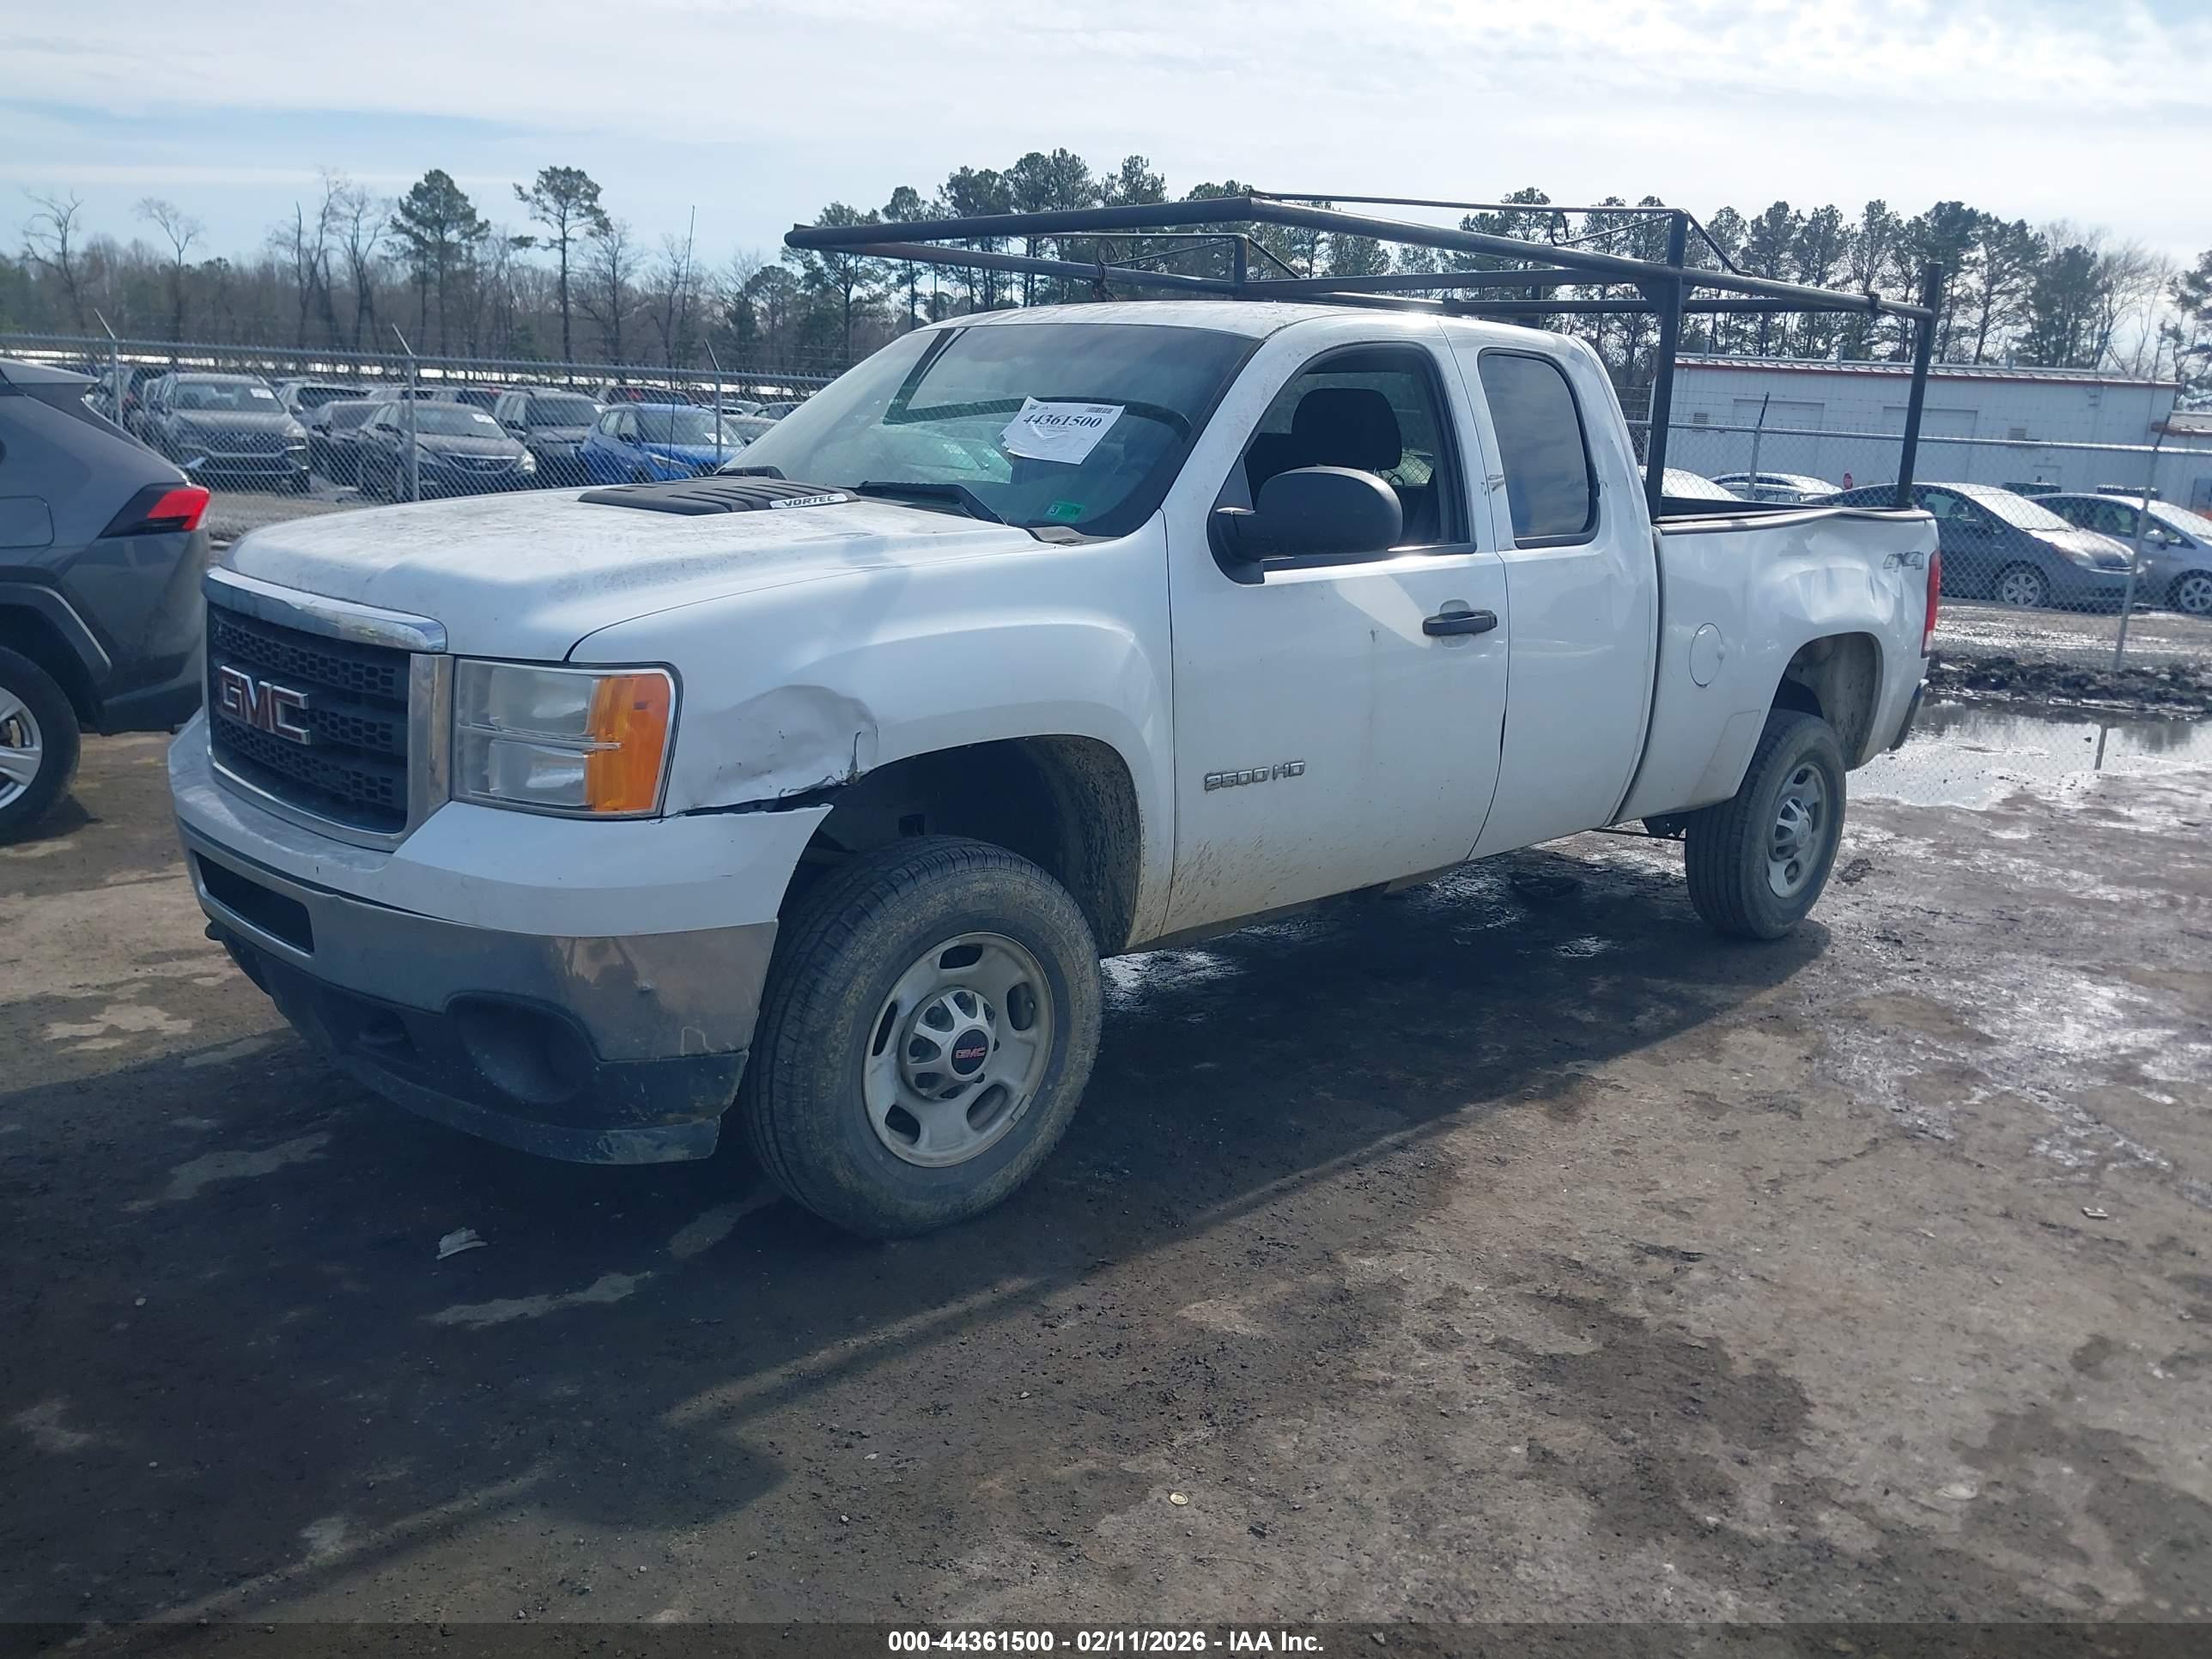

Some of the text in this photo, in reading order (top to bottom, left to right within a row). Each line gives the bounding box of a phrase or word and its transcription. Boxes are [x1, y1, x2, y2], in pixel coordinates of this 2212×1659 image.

[1023, 414, 1103, 428] 44361500
[781, 495, 835, 507] VORTEC
[220, 665, 311, 745] GMC
[1204, 761, 1305, 792] 2500 HD
[955, 1047, 987, 1060] GMC
